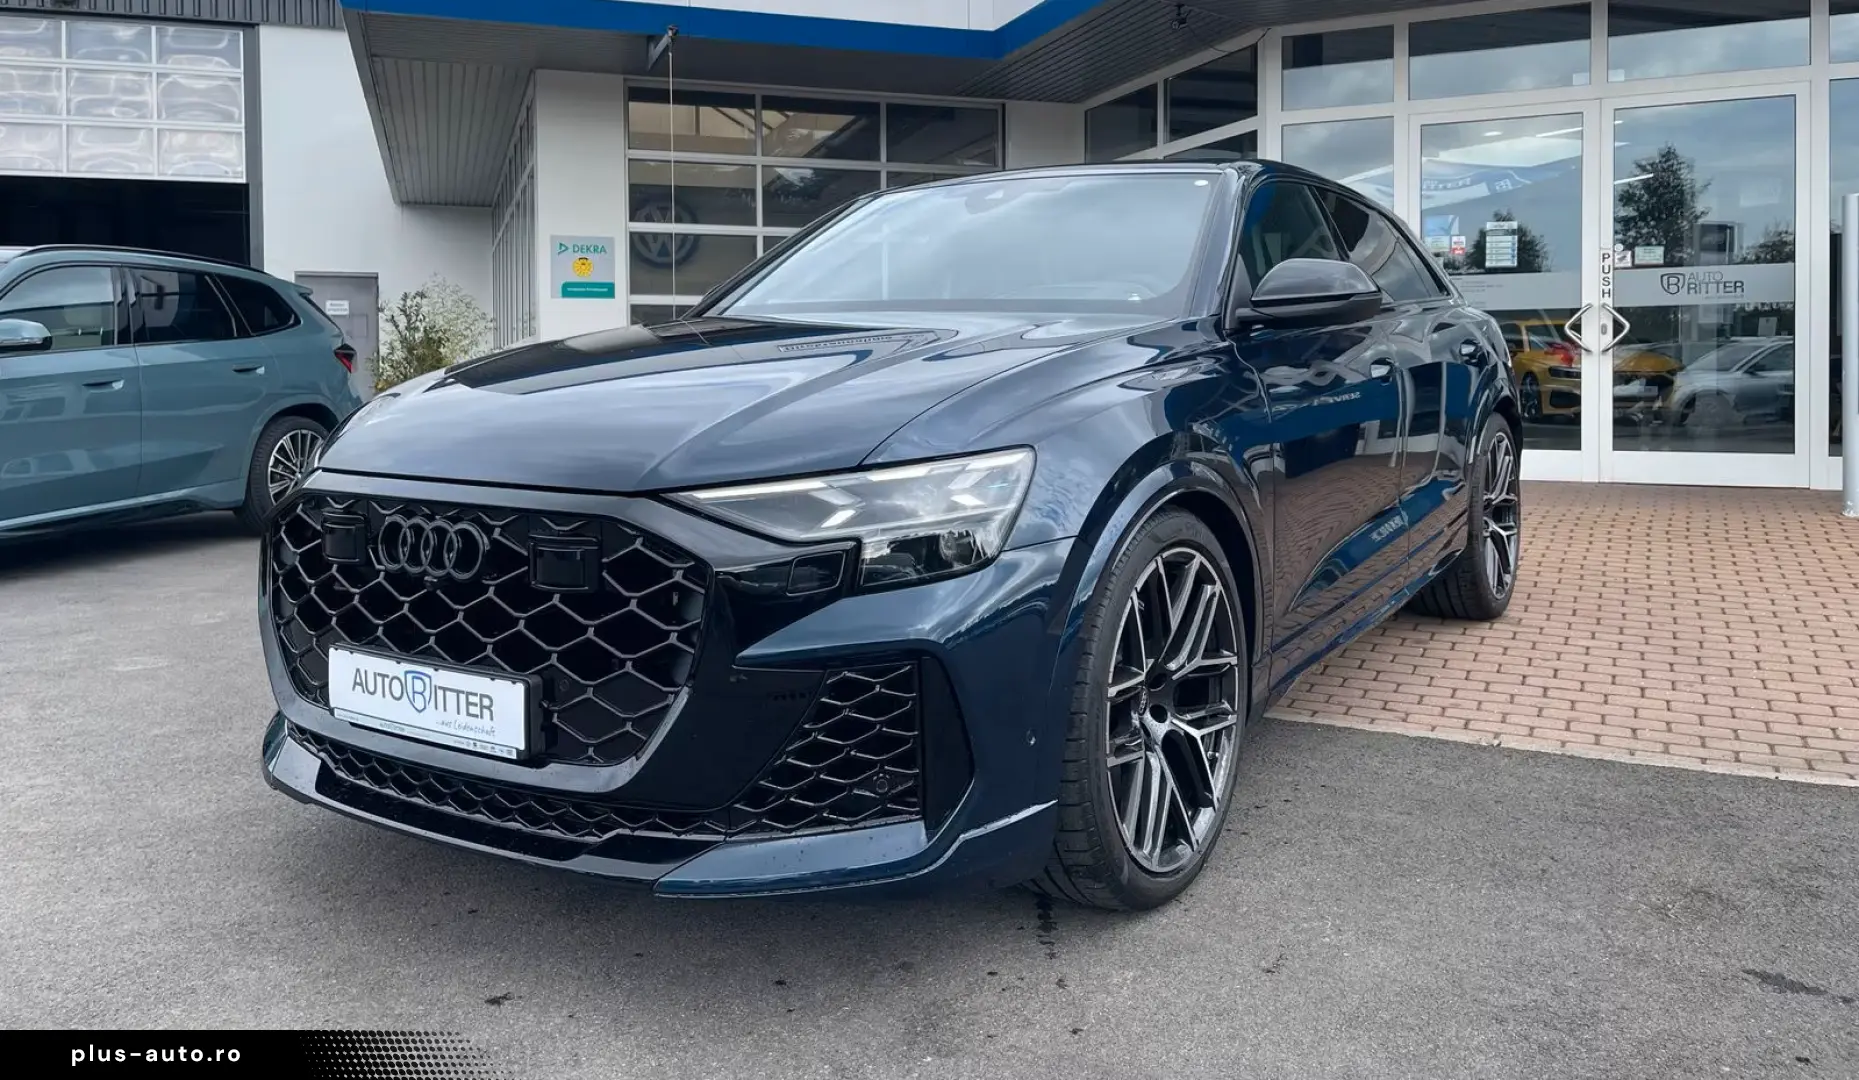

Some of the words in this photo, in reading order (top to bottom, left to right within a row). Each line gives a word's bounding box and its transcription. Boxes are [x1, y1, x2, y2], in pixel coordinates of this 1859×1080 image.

[572, 243, 608, 254] DEKRA
[1601, 252, 1611, 299] PUSH
[1687, 271, 1723, 282] AUTO
[1687, 280, 1745, 295] RITTER
